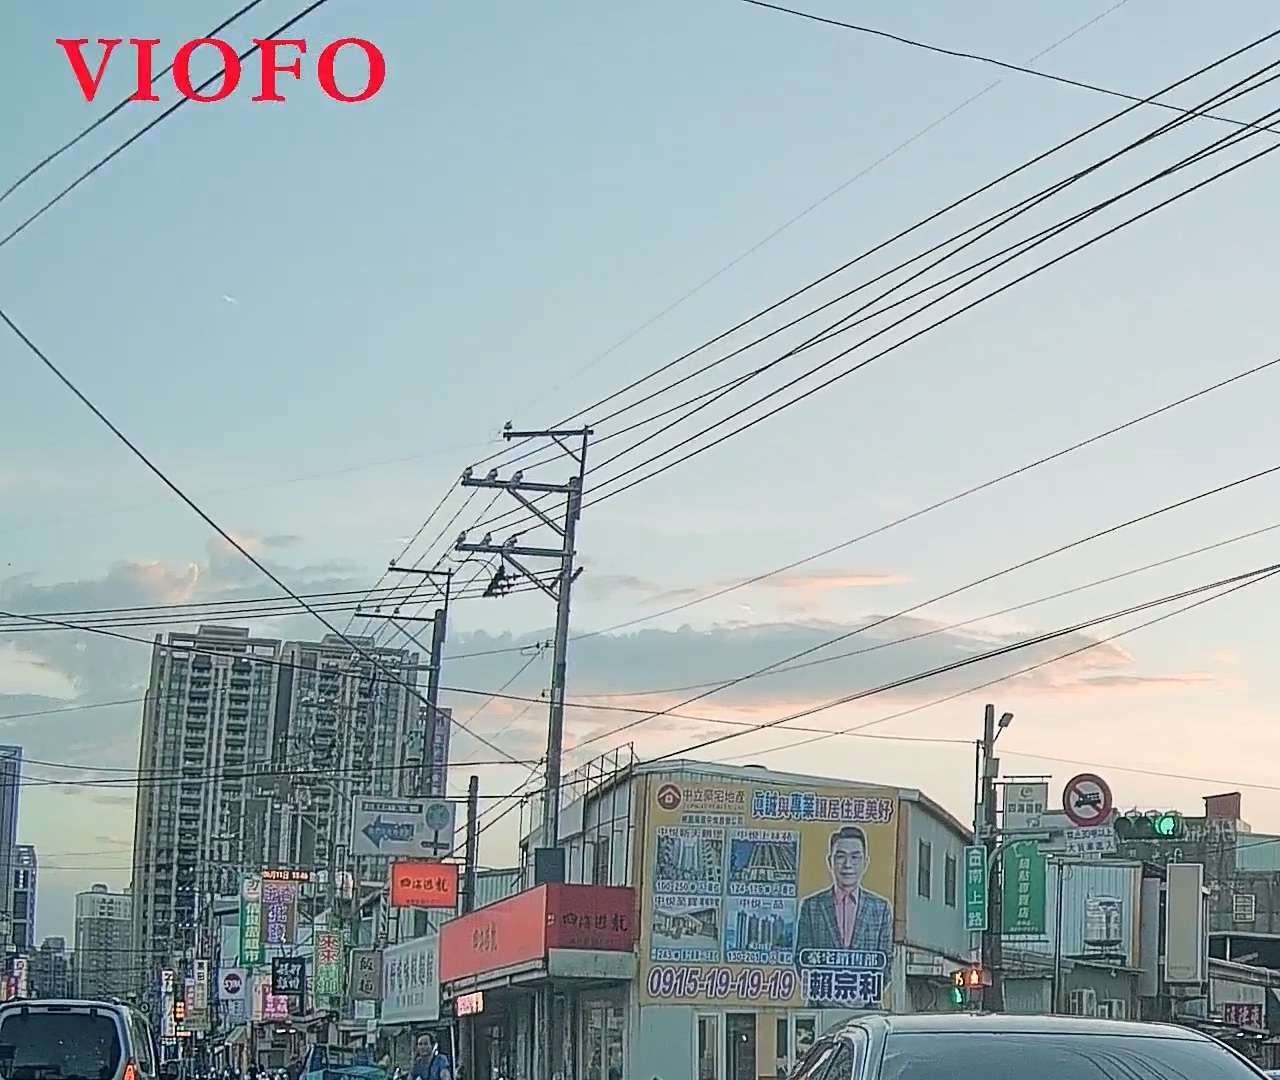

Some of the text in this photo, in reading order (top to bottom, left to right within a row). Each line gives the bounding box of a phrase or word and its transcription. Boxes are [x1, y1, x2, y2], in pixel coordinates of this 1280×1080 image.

[647, 965, 797, 999] 0915-19-19-19
[809, 970, 882, 1002] 賴宗利
